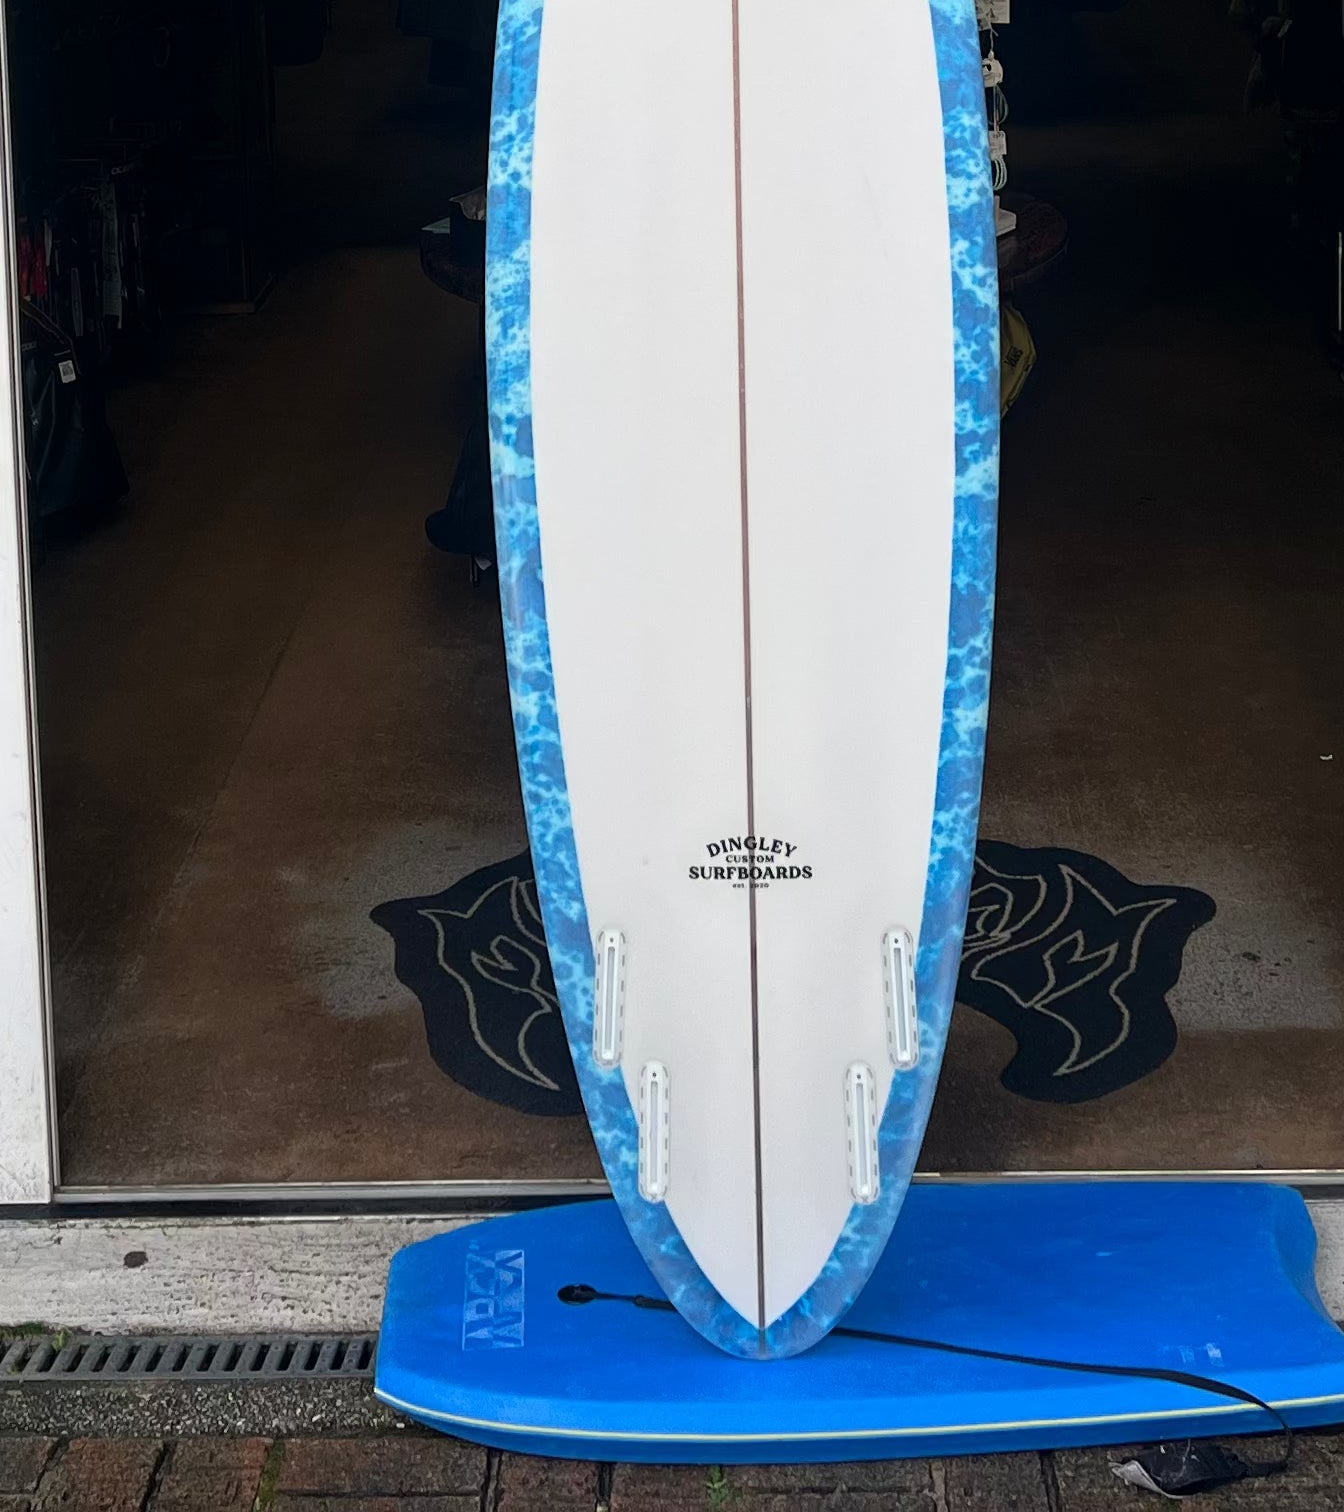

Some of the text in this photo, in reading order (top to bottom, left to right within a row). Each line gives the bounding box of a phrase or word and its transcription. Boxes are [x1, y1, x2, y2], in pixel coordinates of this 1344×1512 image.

[705, 836, 798, 858] DINGLEY
[725, 855, 775, 864] CUSTOM
[688, 865, 814, 880] SURFBOARDS
